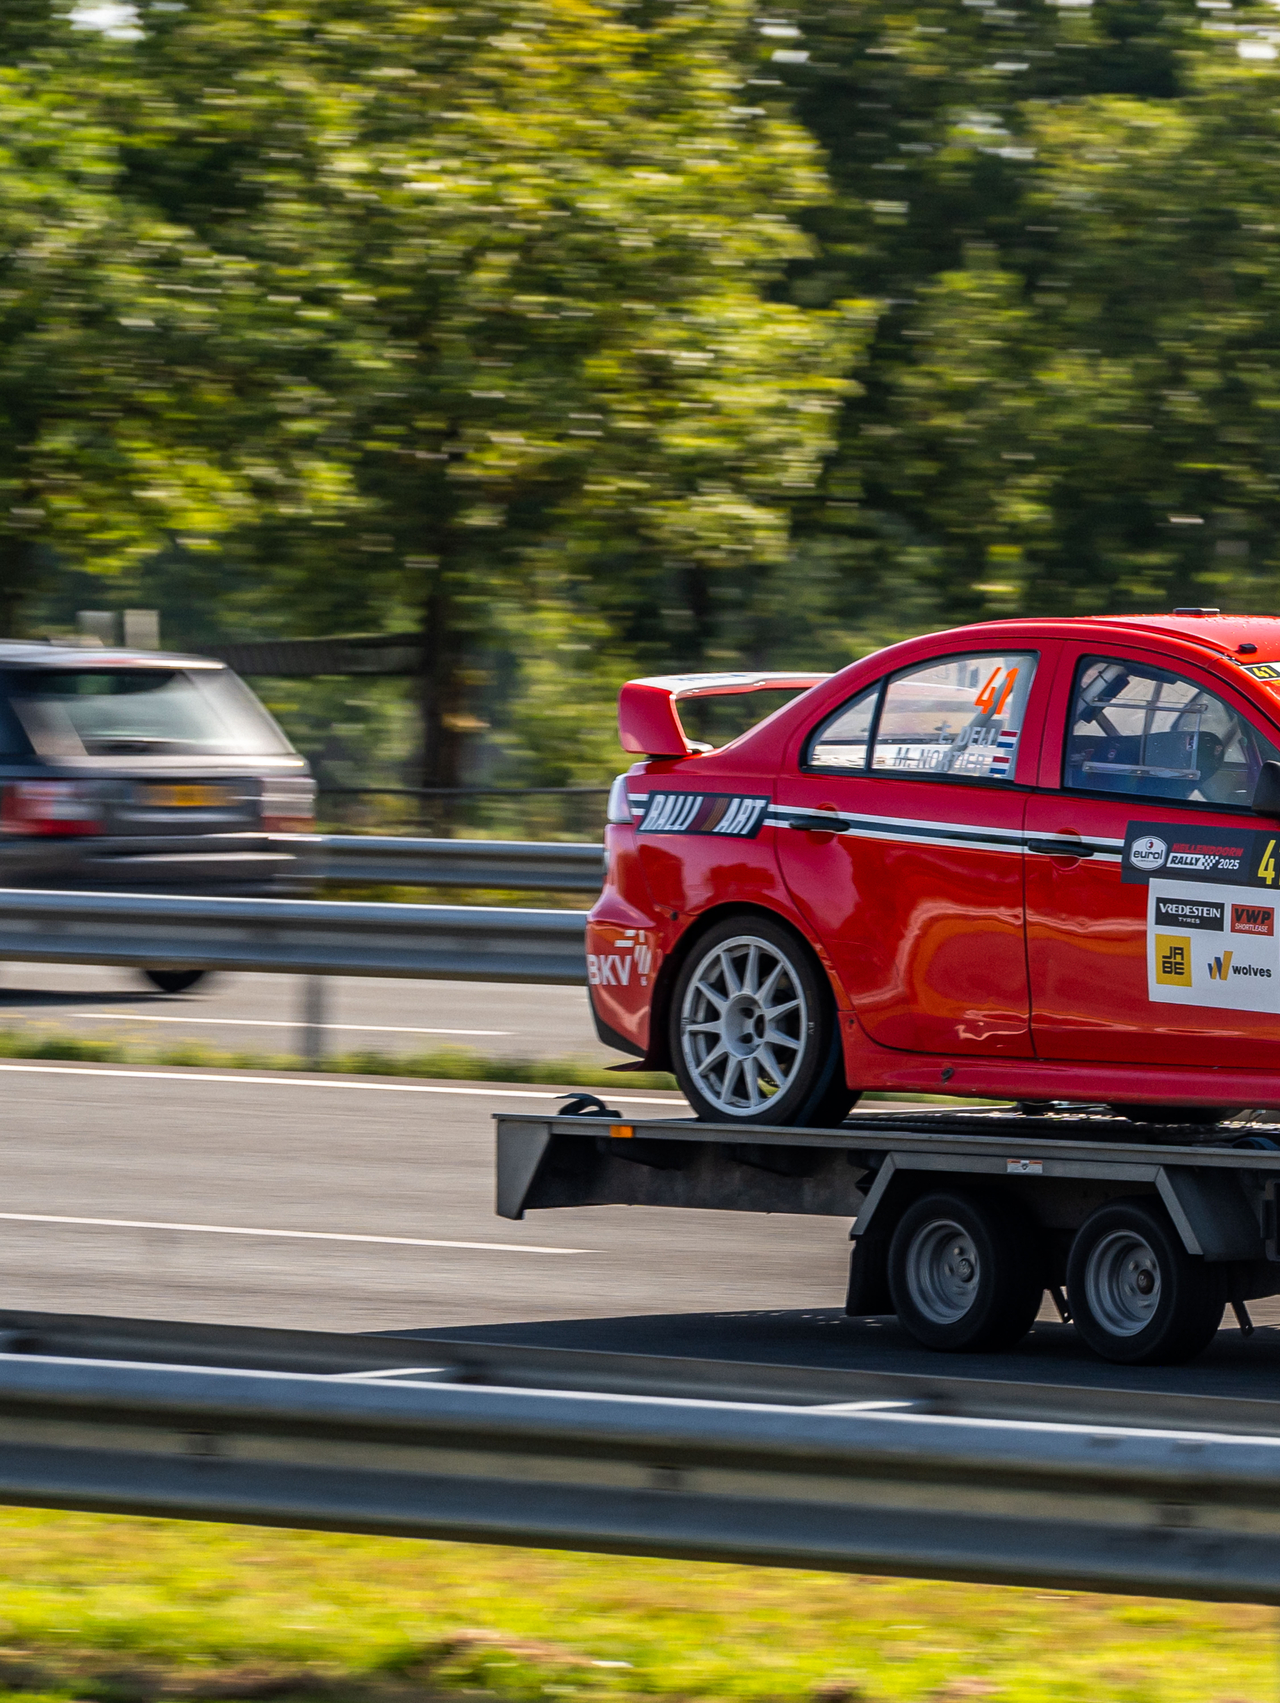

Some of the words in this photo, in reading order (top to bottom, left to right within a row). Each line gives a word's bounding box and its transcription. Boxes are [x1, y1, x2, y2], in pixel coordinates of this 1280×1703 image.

[1252, 666, 1278, 677] 41
[974, 667, 1019, 715] 41
[957, 725, 996, 747] DEIJ
[1133, 849, 1164, 860] eurol
[1171, 843, 1244, 857] HELLENDOORN
[1170, 855, 1201, 867] RALLY
[1217, 859, 1240, 870] 2025
[1159, 903, 1221, 919] VREDESTEIN
[1234, 908, 1271, 924] VWP
[1235, 923, 1269, 933] SHORTLEASE
[1162, 946, 1184, 961] JA
[587, 954, 632, 986] BKV
[1162, 961, 1185, 976] BE
[1232, 964, 1272, 978] wolves
